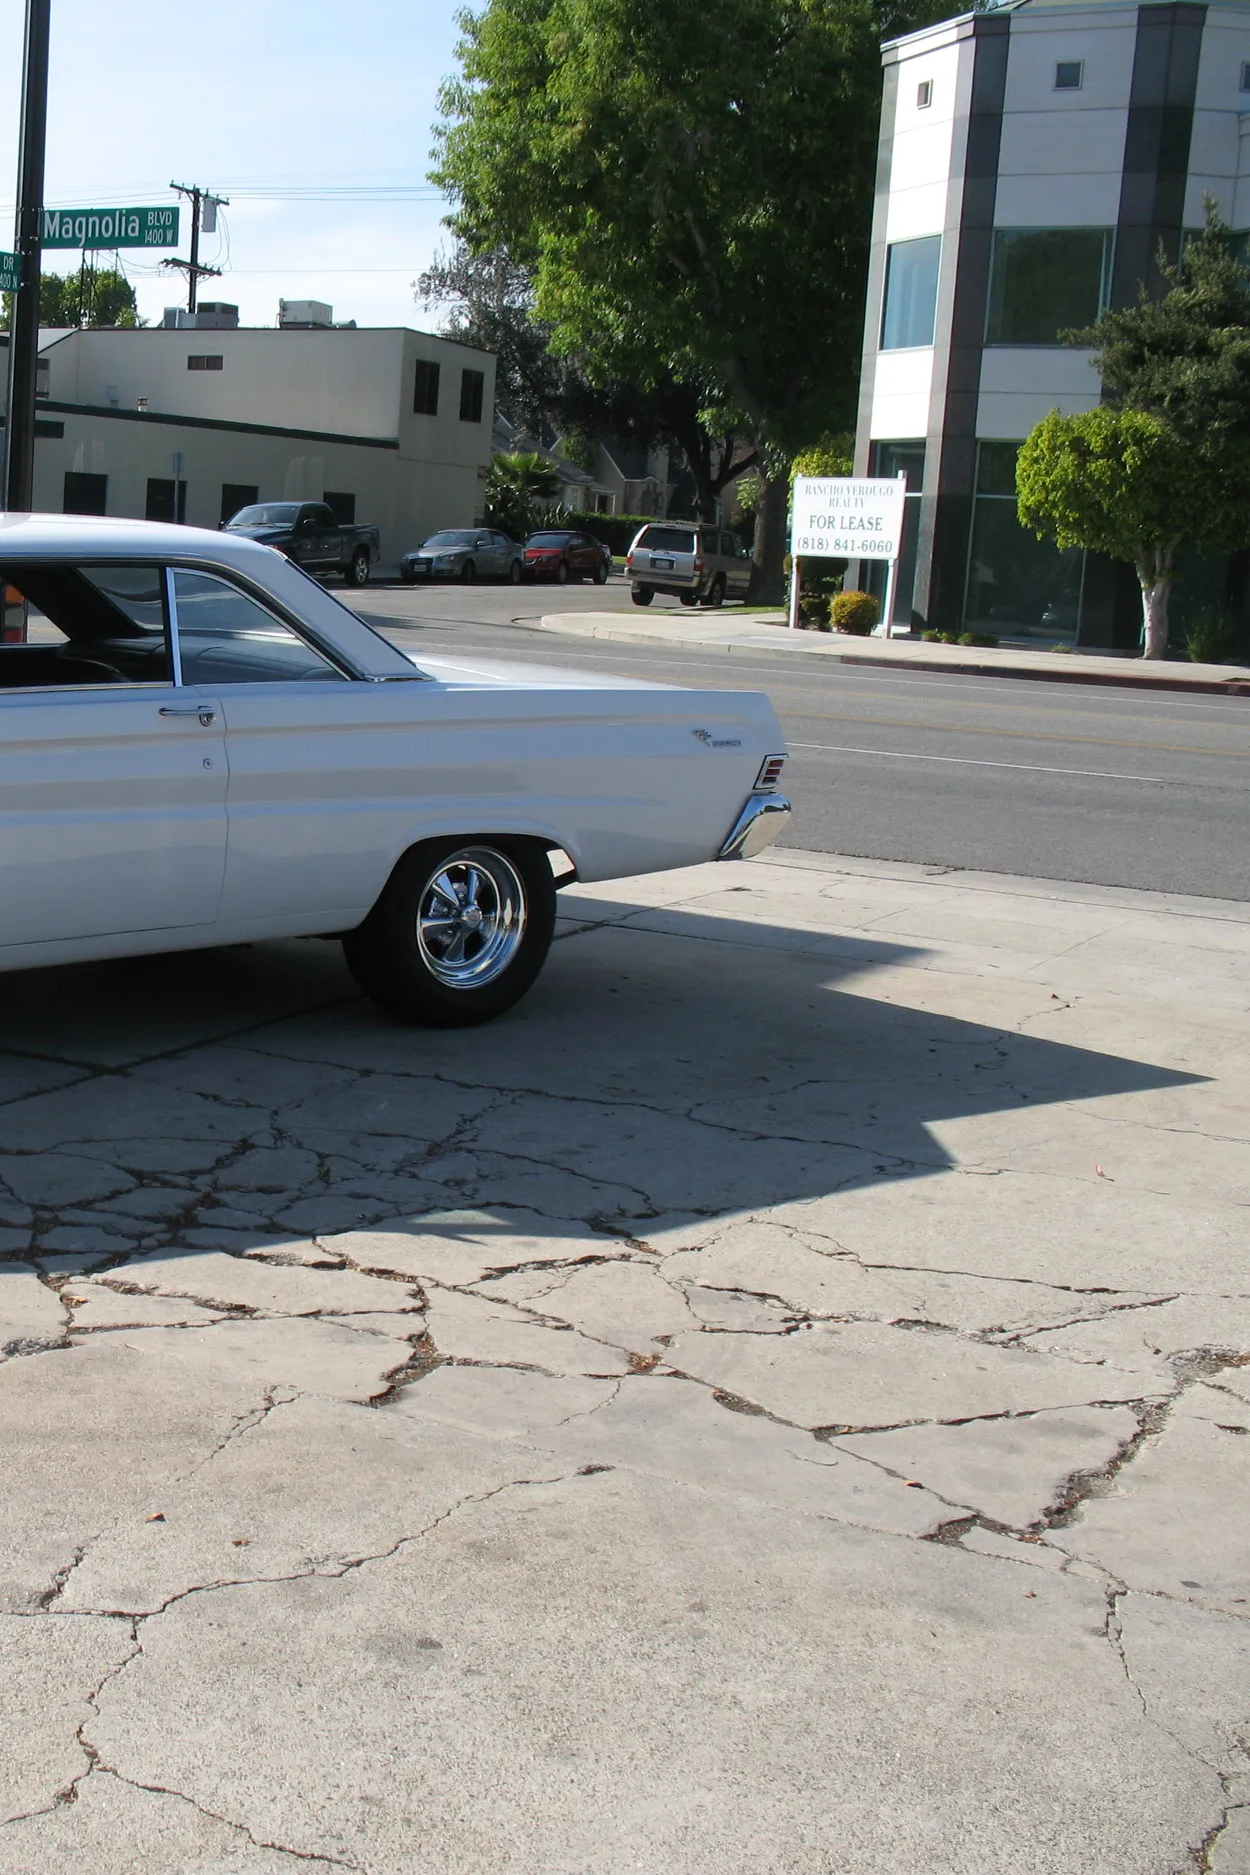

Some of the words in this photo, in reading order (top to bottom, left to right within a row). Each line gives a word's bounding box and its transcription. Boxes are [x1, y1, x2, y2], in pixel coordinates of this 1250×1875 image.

[43, 210, 140, 247] Magnolia
[147, 211, 173, 227] BLVD
[144, 230, 164, 244] 1400
[165, 230, 174, 243] W
[3, 255, 14, 271] DR
[12, 275, 18, 289] N
[805, 484, 844, 496] RANCHO
[846, 485, 894, 497] VERDUGO
[809, 515, 835, 530] FOR
[840, 516, 883, 531] LEASE
[797, 537, 829, 551] (818)
[834, 538, 893, 553] 841-6060
